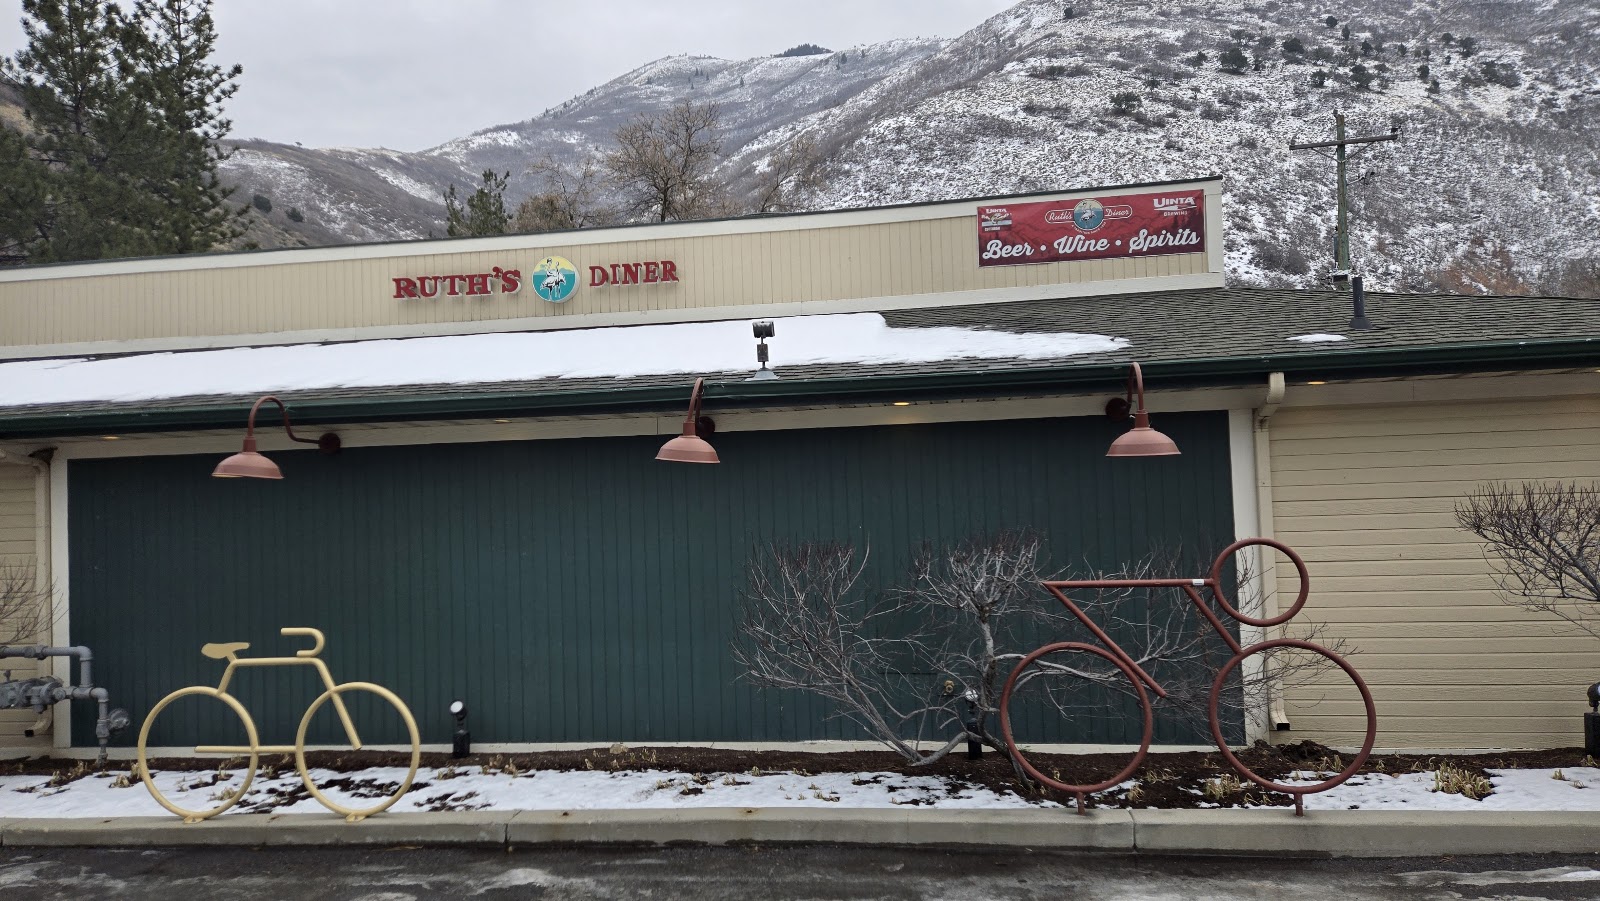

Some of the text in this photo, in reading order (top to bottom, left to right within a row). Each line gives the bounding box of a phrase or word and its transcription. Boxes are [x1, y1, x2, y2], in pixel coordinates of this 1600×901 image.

[1153, 196, 1195, 208] UINTA
[1048, 208, 1129, 221] Ruth's Diner
[982, 239, 1034, 259] Beer
[1054, 234, 1110, 254] Wine
[1129, 228, 1200, 253] Spirits
[392, 260, 679, 299] RUTH'S DINER
